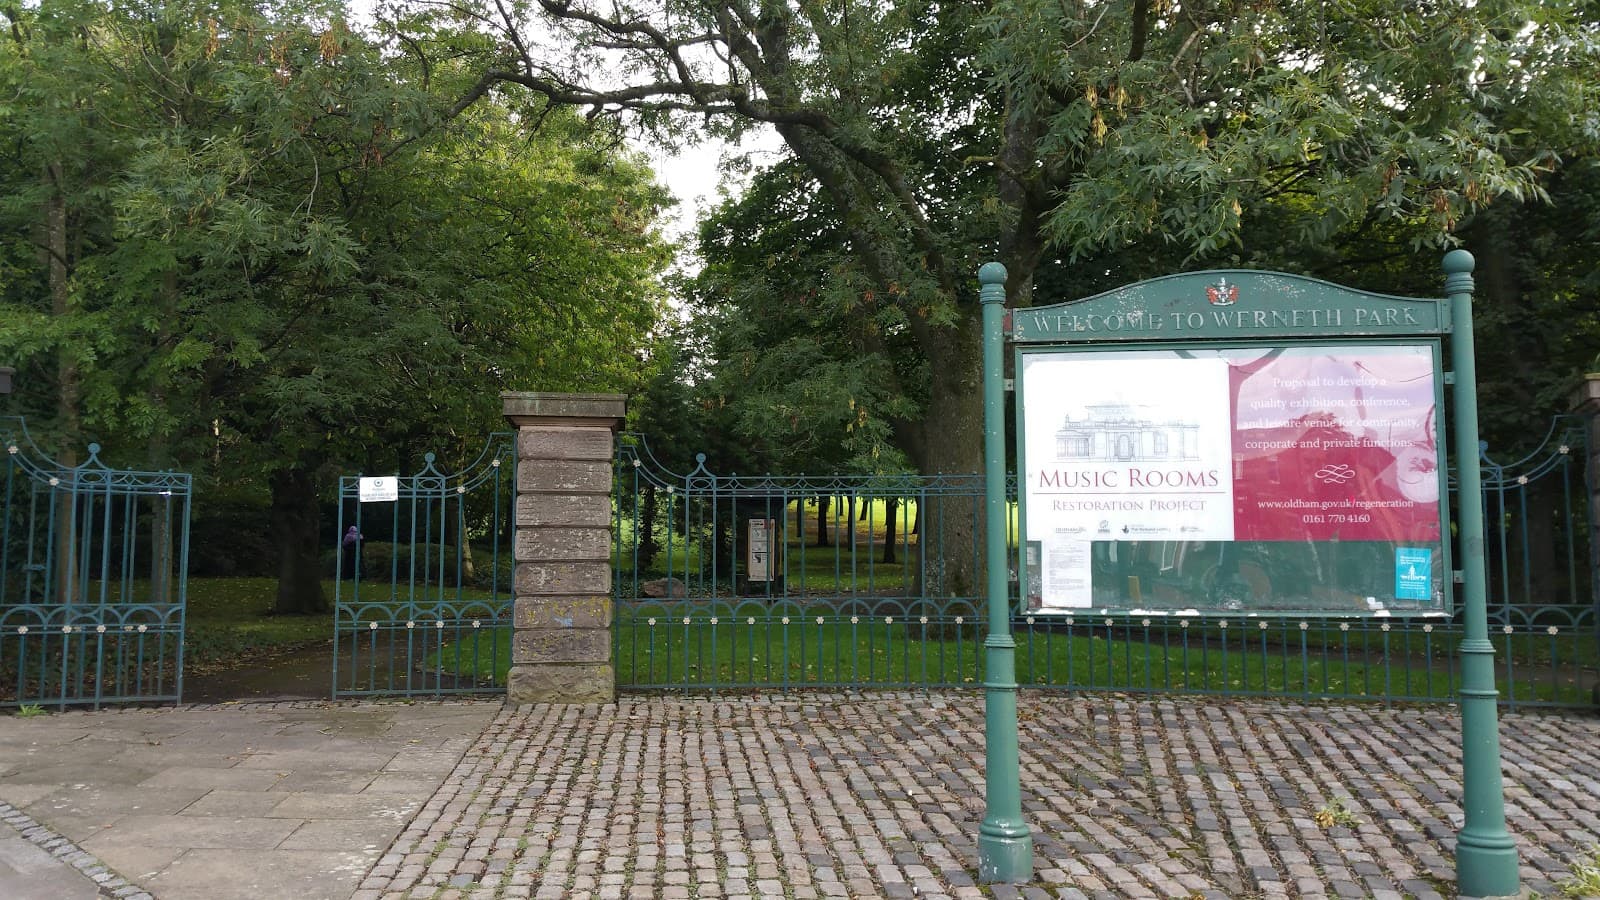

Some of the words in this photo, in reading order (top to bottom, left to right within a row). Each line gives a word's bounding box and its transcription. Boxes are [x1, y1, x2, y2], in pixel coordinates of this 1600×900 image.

[1033, 311, 1161, 333] WELCOME
[1170, 311, 1205, 331] TO
[1209, 307, 1342, 329] WERNETH
[1355, 307, 1420, 327] PARK
[1272, 376, 1320, 389] Proposal
[1323, 377, 1335, 387] to
[1337, 376, 1377, 389] develop
[1250, 398, 1287, 410] quality
[1243, 419, 1263, 429] and
[1265, 418, 1301, 429] leisure
[1304, 420, 1336, 428] venue
[1339, 418, 1354, 428] for
[1245, 440, 1298, 451] corporate
[1300, 438, 1321, 449] and
[1323, 438, 1360, 451] private
[1039, 469, 1118, 489] MUSIC
[1129, 468, 1219, 488] ROOMS
[1053, 499, 1144, 512] RESTORATION
[1150, 499, 1207, 512] PROJECT
[1258, 497, 1414, 511] www.oldham.gov.uk/regeneration
[1302, 514, 1326, 524] 0161
[1327, 514, 1346, 524] 770
[1347, 514, 1371, 524] 4160
